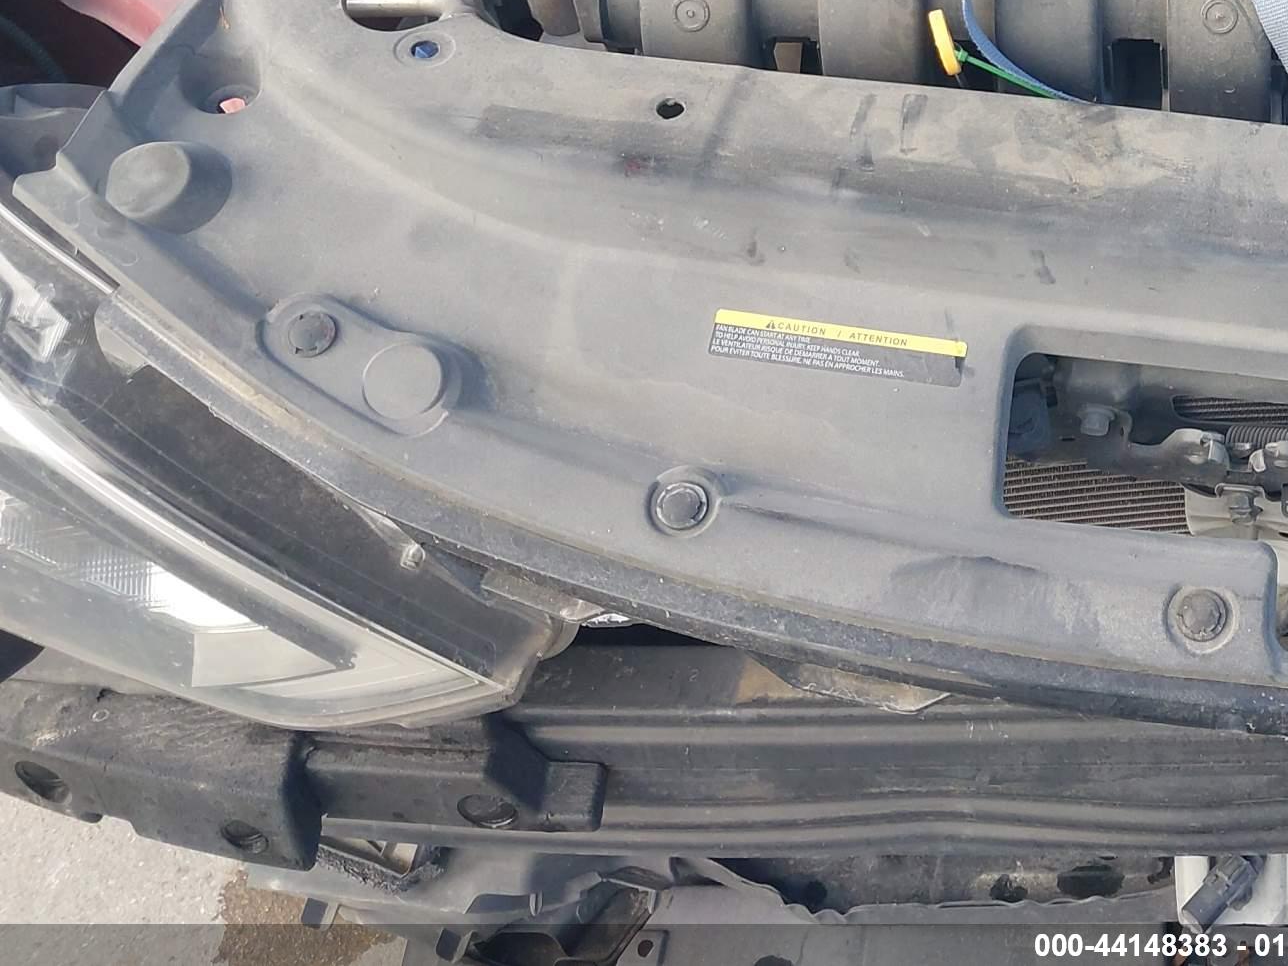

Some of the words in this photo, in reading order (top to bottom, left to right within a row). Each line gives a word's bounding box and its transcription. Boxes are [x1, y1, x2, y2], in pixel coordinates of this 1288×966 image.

[715, 324, 727, 332] FAN
[728, 325, 745, 335] BLADE
[746, 328, 758, 336] CAN
[760, 329, 774, 338] START
[784, 332, 796, 341] ANY
[723, 332, 738, 341] HELP
[738, 334, 755, 343] AVOID
[756, 336, 784, 346] PERSONAL
[806, 342, 820, 351] KEEP
[820, 344, 840, 354] HANDS
[777, 321, 825, 335] CAUTION
[849, 330, 907, 345] ATTENTION
[710, 344, 728, 354] POUR
[751, 349, 770, 360] TOUTE
[812, 357, 824, 367] PAS
[824, 359, 833, 368] EN
[834, 360, 870, 372] APPROCHER
[871, 365, 882, 374] LES
[883, 366, 904, 377] MAINS.
[721, 338, 760, 351] VENTILATEUR
[761, 343, 782, 354] RISQUE
[834, 353, 849, 362] TOUT
[850, 355, 880, 366] MOMENT.
